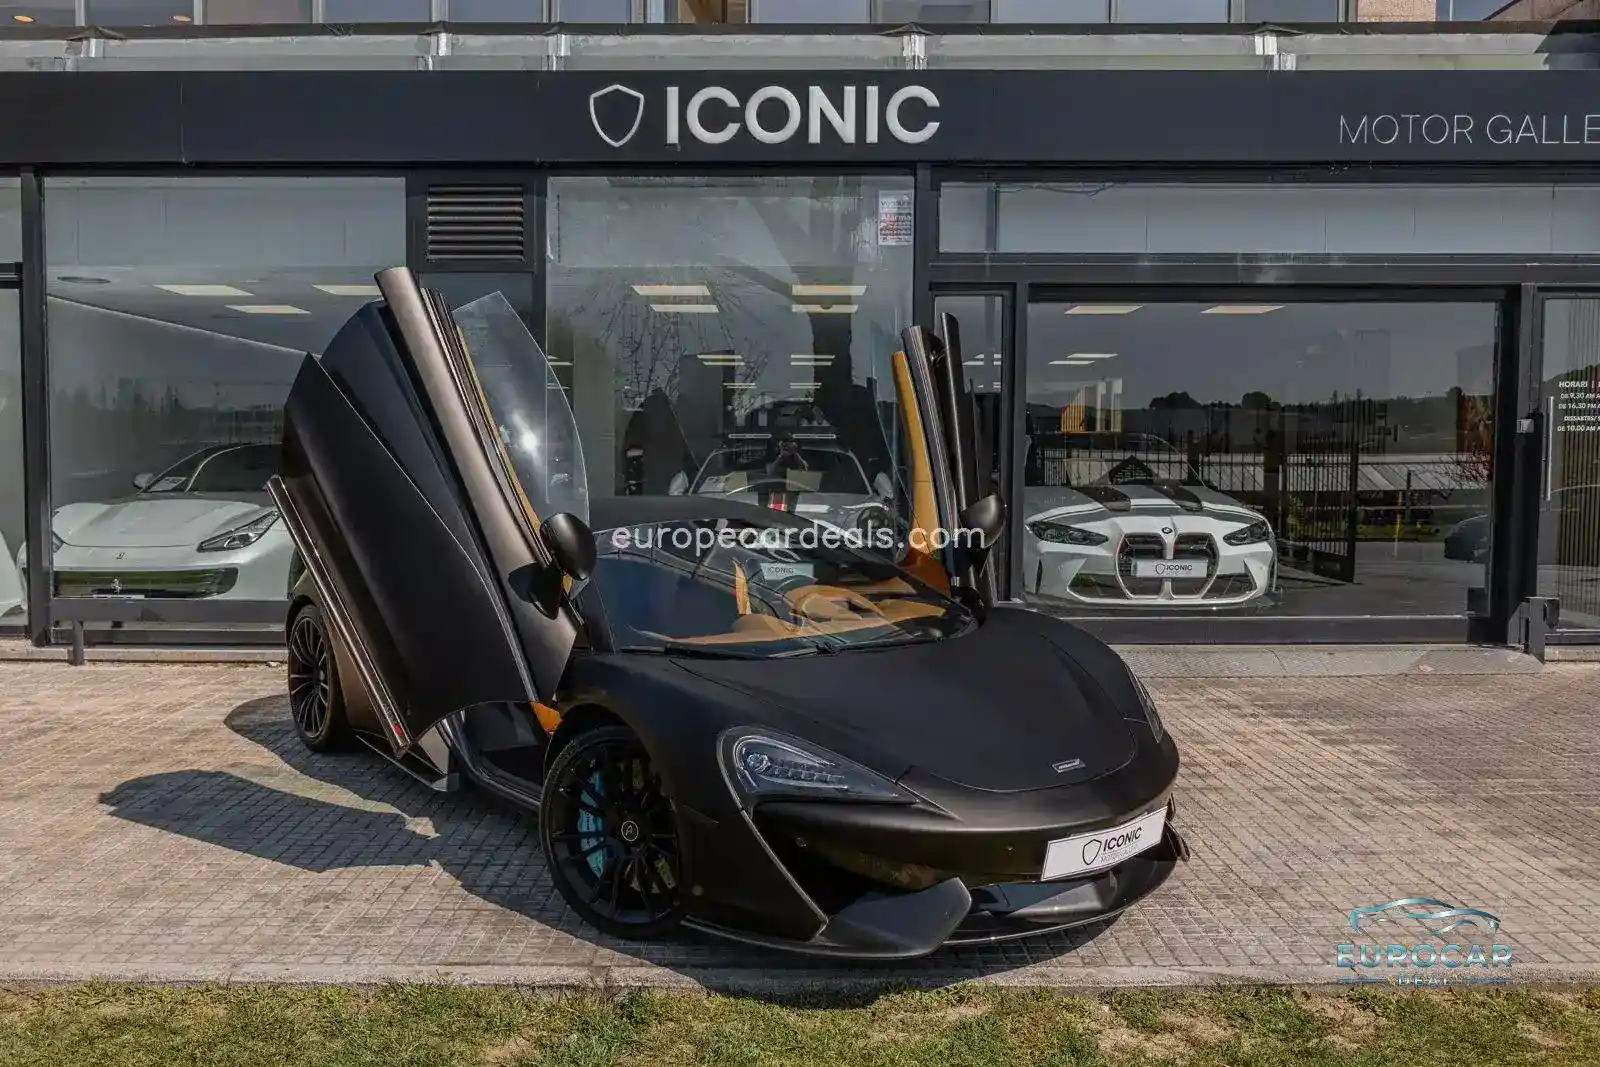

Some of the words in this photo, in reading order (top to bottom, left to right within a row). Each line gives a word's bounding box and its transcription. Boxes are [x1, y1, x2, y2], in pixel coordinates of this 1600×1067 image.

[667, 85, 940, 144] ICONIC
[1339, 114, 1474, 144] MOTOR
[1103, 826, 1142, 852] ICONIC
